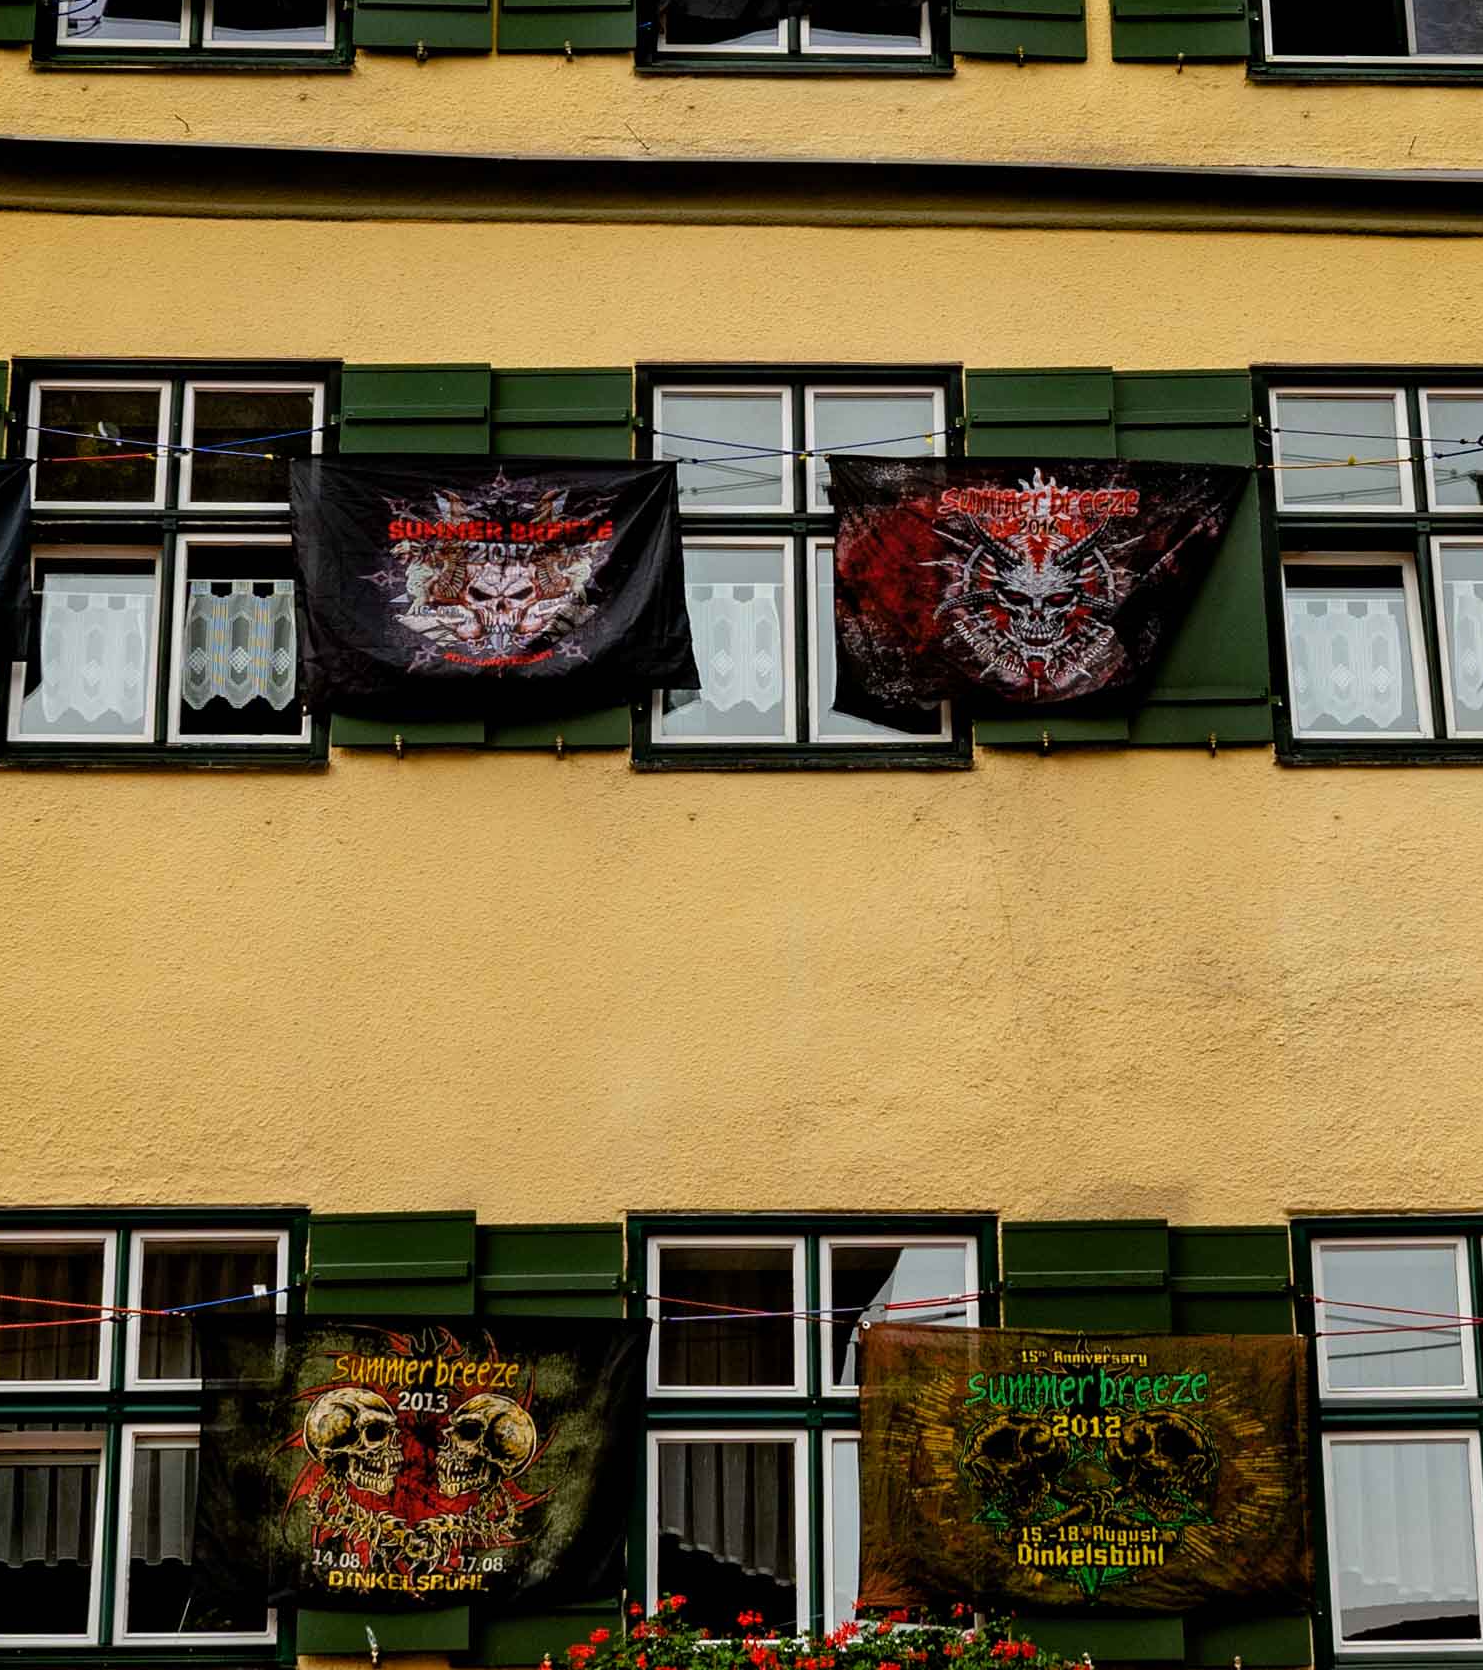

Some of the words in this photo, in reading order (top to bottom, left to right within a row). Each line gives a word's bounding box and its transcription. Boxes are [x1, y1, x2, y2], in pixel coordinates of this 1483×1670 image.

[388, 520, 505, 542] SUMMER
[1053, 1349, 1149, 1367] Anniversary
[397, 1391, 449, 1414] 2013
[1051, 1413, 1122, 1439] 2012
[1092, 1524, 1159, 1546] August
[311, 1549, 365, 1569] 14.08.
[458, 1554, 508, 1573] 17.08.
[1017, 1542, 1165, 1566] Dinkelsbühl
